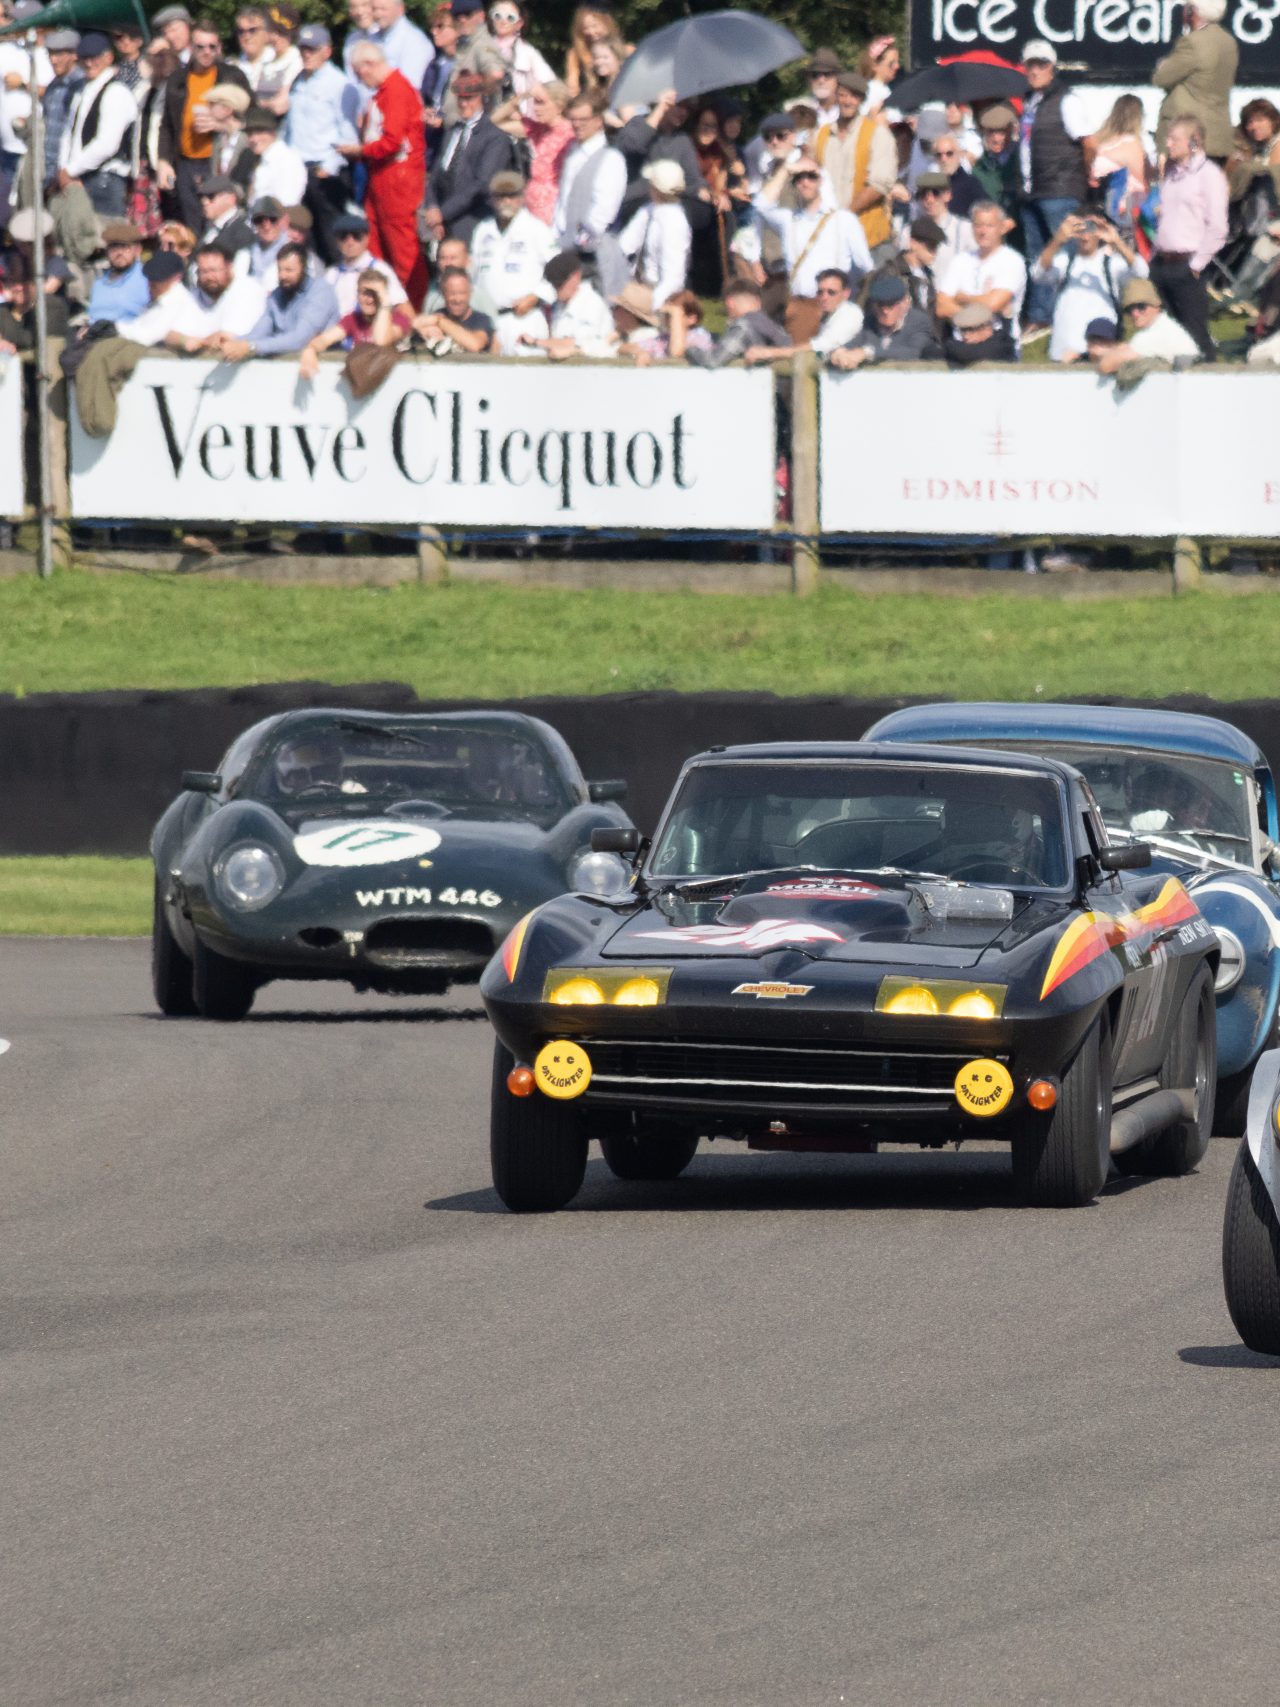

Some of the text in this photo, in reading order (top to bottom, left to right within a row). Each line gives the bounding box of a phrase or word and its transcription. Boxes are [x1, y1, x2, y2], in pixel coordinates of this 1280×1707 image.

[931, 0, 1017, 43] Ice
[146, 385, 697, 511] Veuve Clicquot
[902, 478, 1100, 502] EDMISTON
[322, 827, 421, 852] 17
[355, 886, 503, 908] WTM 446
[742, 984, 806, 994] CHEVROLET
[542, 1065, 584, 1087] DAYLIGHTER
[961, 1084, 1003, 1106] DAYLIGHTER
